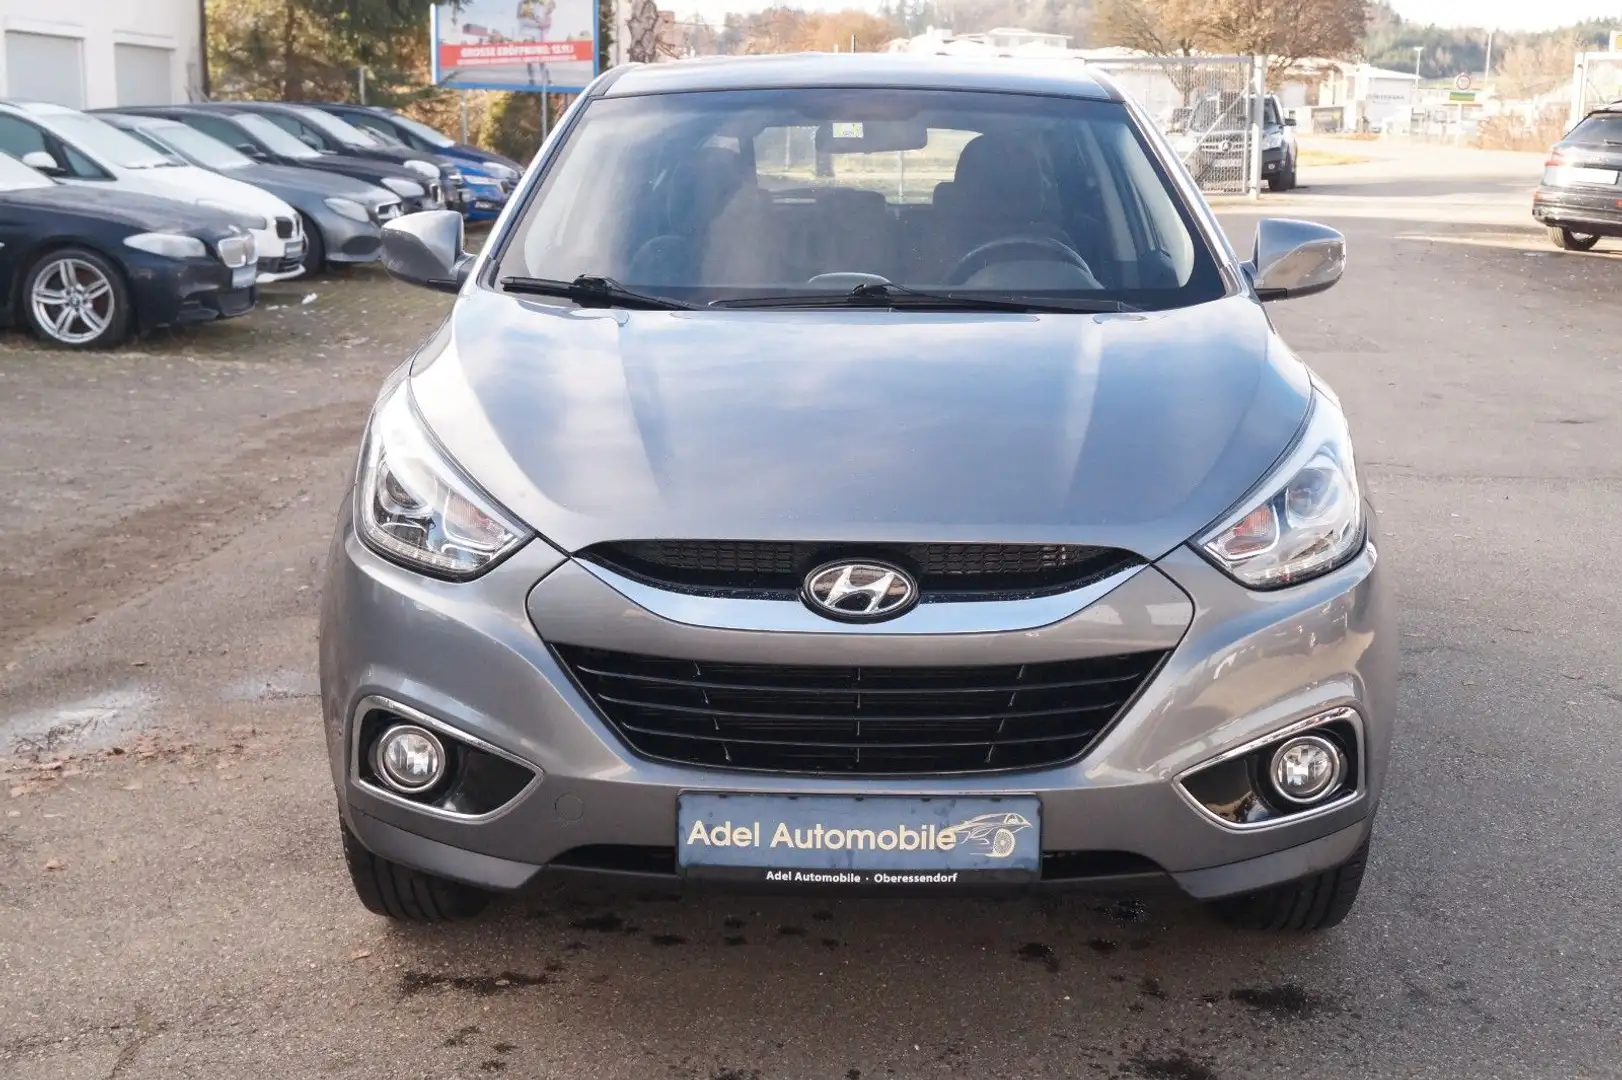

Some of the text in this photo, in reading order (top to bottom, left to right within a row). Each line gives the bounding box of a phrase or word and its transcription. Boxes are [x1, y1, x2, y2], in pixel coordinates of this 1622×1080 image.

[686, 820, 957, 851] Adel Automobile
[766, 870, 958, 883] Adel Automobile Oberessendorf
